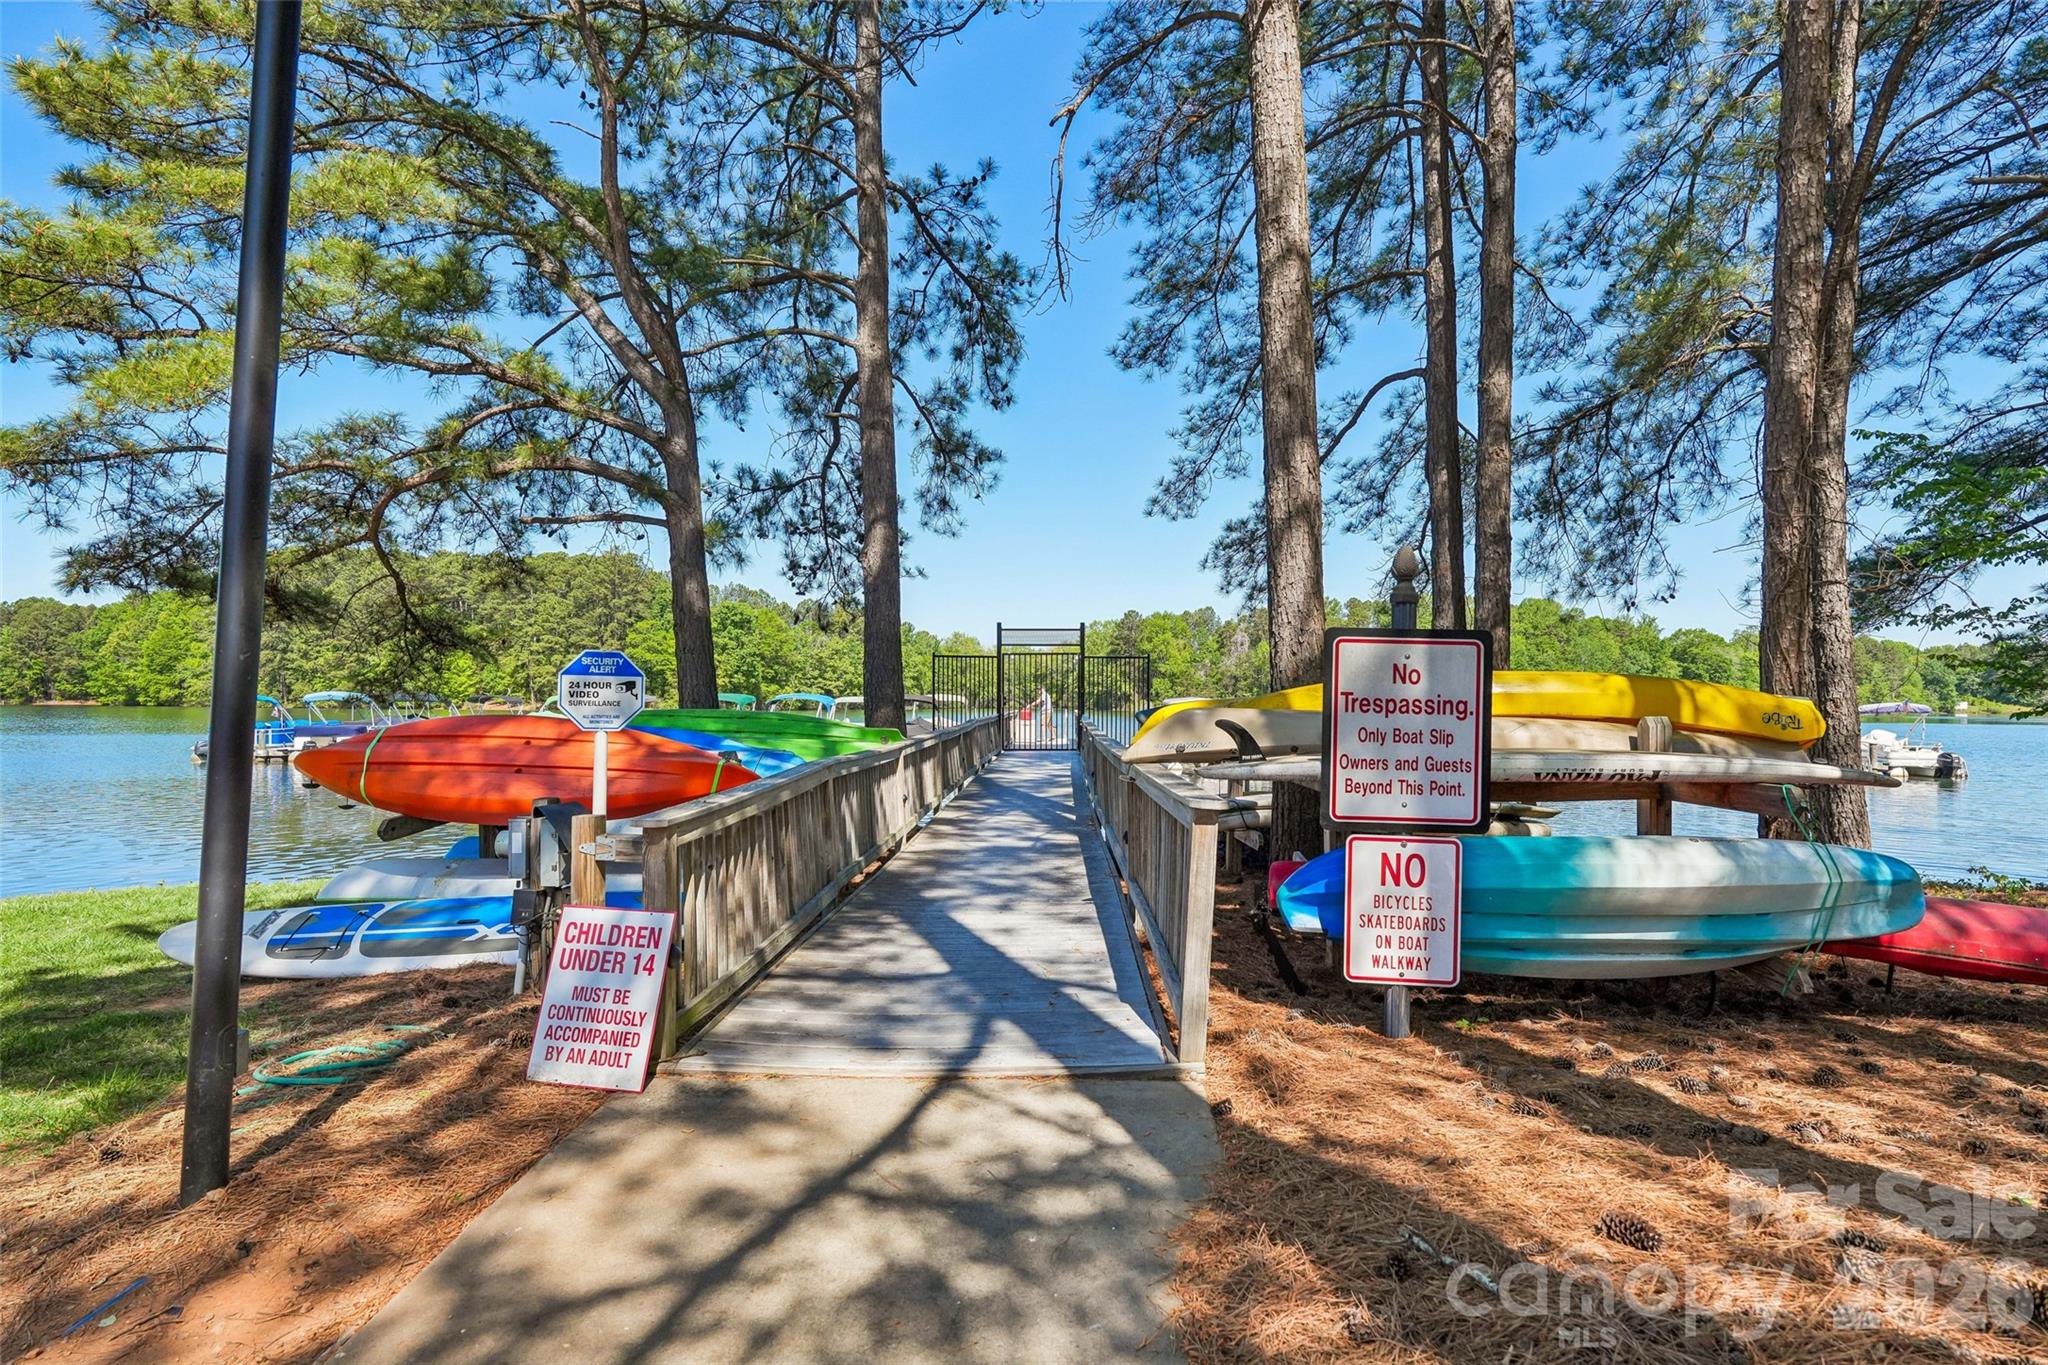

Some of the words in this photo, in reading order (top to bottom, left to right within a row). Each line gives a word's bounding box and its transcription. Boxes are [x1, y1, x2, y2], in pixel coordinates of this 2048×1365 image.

[581, 656, 624, 666] SECURITY
[589, 665, 617, 674] ALERT
[1392, 663, 1421, 685] No
[568, 682, 580, 690] 24
[583, 681, 612, 690] HOUR
[568, 690, 600, 699] VIDEO
[568, 699, 622, 707] SURVEILLANCE
[1340, 692, 1474, 721] Trespassing.
[1358, 727, 1387, 746] Only
[1392, 728, 1424, 745] Boat
[1429, 729, 1454, 748] Slip
[1339, 754, 1388, 771] Owners
[1394, 756, 1419, 771] and
[1424, 756, 1472, 774] Guests
[1344, 778, 1392, 797] Beyond
[1397, 779, 1424, 796] This
[1429, 781, 1465, 797] Point.
[1380, 852, 1426, 888] NO
[1373, 894, 1433, 911] BICYCLES
[1359, 914, 1446, 932] SKATEBOARDS
[563, 921, 663, 950] CHILDREN
[1375, 934, 1391, 949] ON
[1398, 936, 1430, 951] BOAT
[559, 948, 626, 974] UNDER
[633, 953, 656, 976] 14
[1371, 954, 1432, 972] WALKWAY
[571, 986, 610, 1004] MUST
[612, 989, 631, 1005] BE
[547, 1004, 648, 1028] CONTINUOUSLY
[543, 1024, 641, 1048] ACCOMPANIED
[544, 1045, 566, 1062] BY
[566, 1048, 586, 1064] AN
[588, 1049, 632, 1069] ADULT
